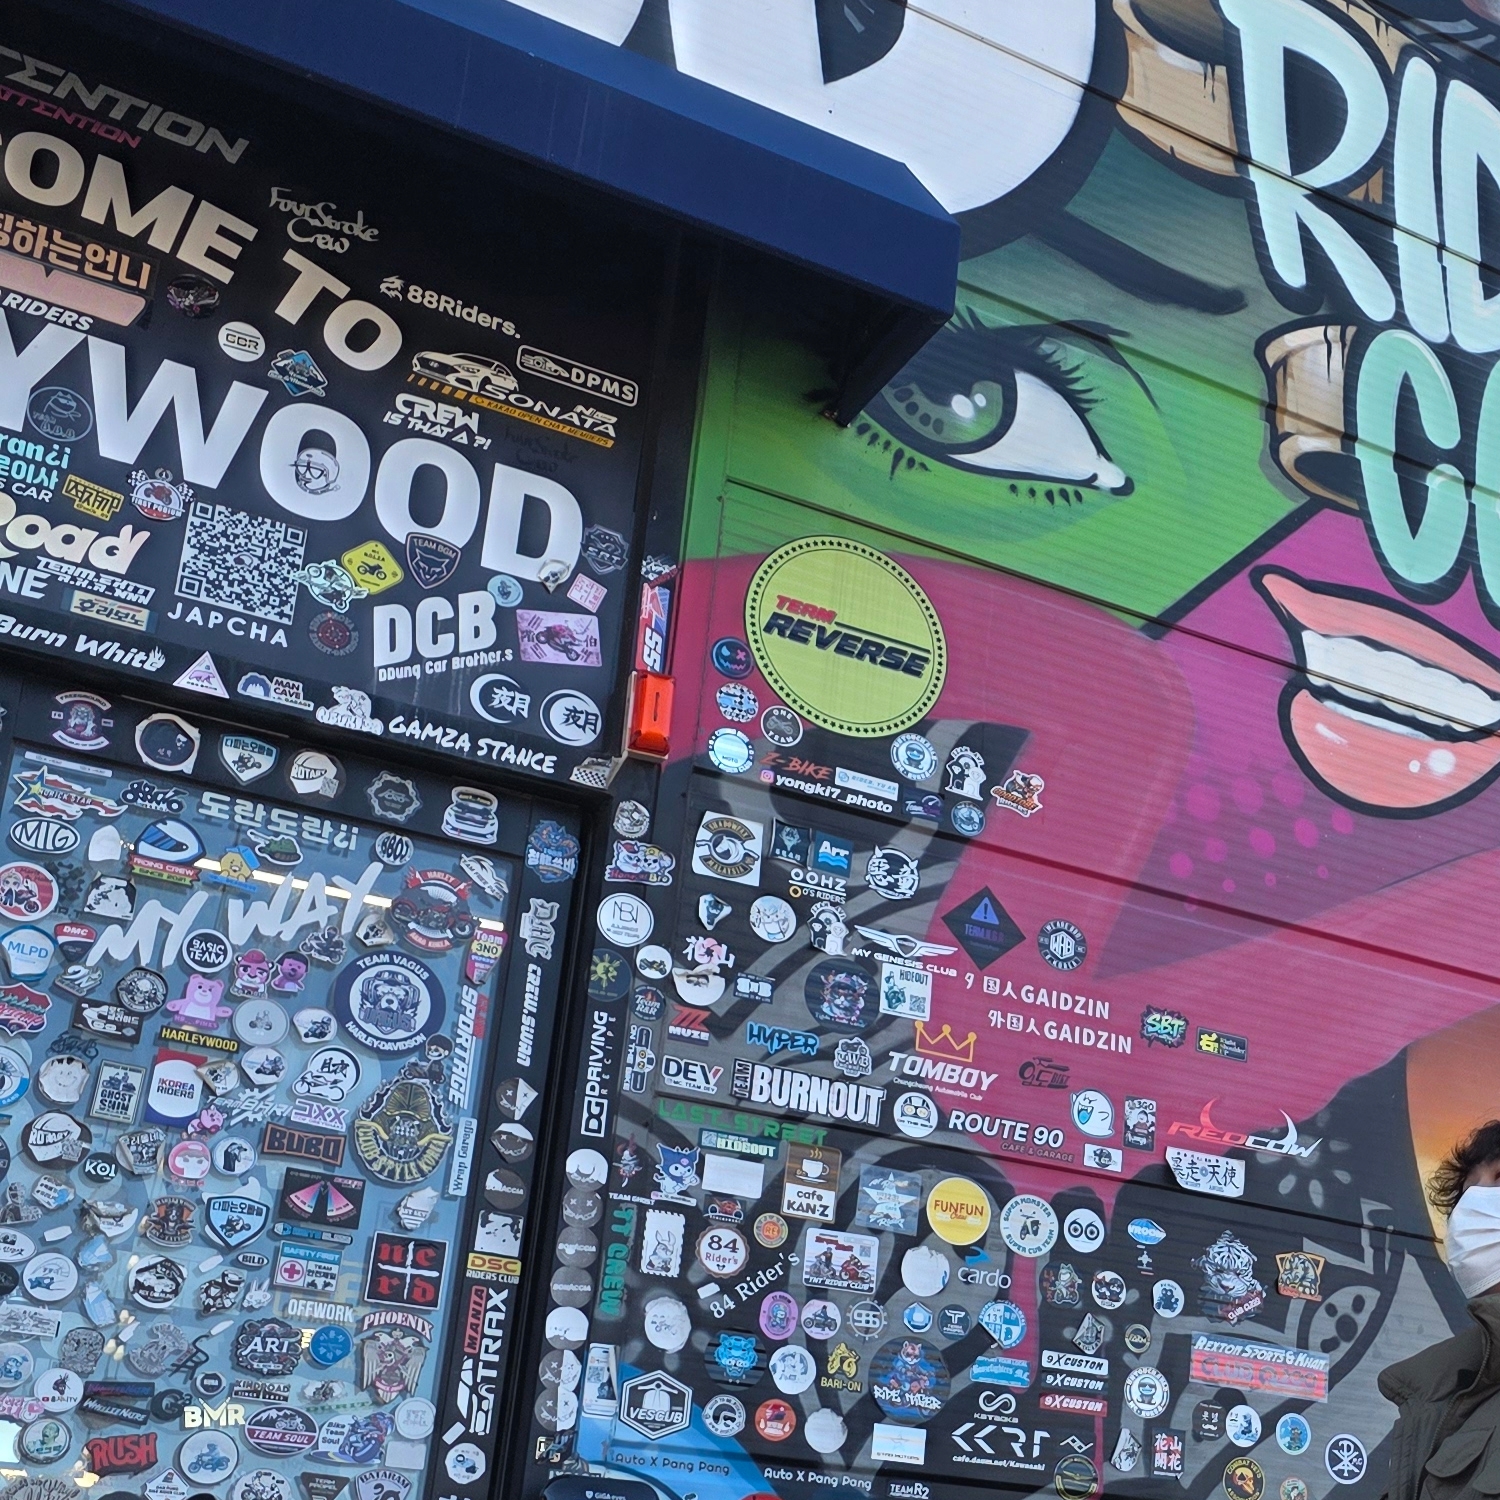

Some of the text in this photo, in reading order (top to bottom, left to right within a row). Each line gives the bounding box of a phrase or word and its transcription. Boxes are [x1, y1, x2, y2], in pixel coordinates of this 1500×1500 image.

[287, 218, 348, 253] Crew
[0, 131, 402, 371] OME TO
[5, 291, 94, 331] RIDERS
[407, 284, 521, 339] 88Riders.
[570, 367, 636, 403] DPMS
[395, 393, 479, 433] CREW
[481, 382, 617, 438] SONATA
[12, 484, 53, 502] CAR
[775, 595, 837, 624] TEAM
[167, 602, 288, 648] JAPCHA
[374, 590, 497, 667] DCB
[75, 635, 165, 672] White
[763, 612, 932, 678] REVERSE
[426, 658, 447, 675] Car
[273, 687, 302, 700] CAVE
[274, 678, 302, 690] MAN
[491, 686, 531, 718] 夜月
[562, 706, 599, 735] 夜月
[388, 715, 557, 774] GAMZA STANCE
[760, 752, 833, 780] Z-BIKE
[775, 773, 894, 814] yongki7_photo
[86, 861, 384, 968] MY WAY
[62, 923, 89, 938] DMC
[474, 930, 504, 945] Team
[8, 941, 49, 959] MLPD
[189, 946, 227, 965] TEAM
[193, 937, 226, 956] BASIC
[356, 955, 430, 981] TEAM VAGUS
[851, 948, 957, 977] MY GENESIS CLUB
[900, 970, 929, 987] HIDEOUT
[161, 1027, 239, 1052] HARLEYWOOD
[346, 1022, 428, 1054] HARLEY-DAVIDSON
[448, 984, 478, 1112] SPORTAGE
[747, 1024, 820, 1054] HYPER
[586, 1010, 609, 1095] DRIVING
[662, 1056, 724, 1084] DEV
[889, 1052, 998, 1091] TOMBOY
[101, 1088, 133, 1105] GHOST
[156, 1086, 195, 1101] RIDERS
[158, 1077, 196, 1092] KOREA
[734, 1060, 750, 1097] TEAM
[751, 1065, 885, 1126] BURNOUT
[949, 1109, 1065, 1149] ROUTE 90
[266, 1126, 342, 1165] BUBO
[717, 1139, 776, 1157] HIDEOUT
[1002, 1142, 1026, 1154] CAFE
[1037, 1149, 1074, 1163] GARAGE
[797, 1189, 824, 1202] cafe
[934, 1200, 985, 1217] FUNFUN
[705, 1251, 739, 1266] Rider's
[708, 1236, 739, 1253] 84
[466, 1268, 520, 1285] RIDERS CLUB
[469, 1255, 520, 1272] DSC
[958, 1264, 1012, 1289] cardo
[708, 1250, 801, 1319] 84 Rider's
[287, 1297, 354, 1324] OFFWORK
[466, 1288, 487, 1352] MANIA
[363, 1311, 434, 1341] PHOENIX
[244, 1336, 290, 1354] ARI
[821, 1377, 862, 1392] BARI-ON
[184, 1397, 246, 1428] BMR
[252, 1428, 310, 1445] TEAM SOUL
[90, 1433, 159, 1470] RUSH
[615, 1453, 730, 1477] Auto X Pang Pang
[764, 1467, 873, 1492] Auto X Pang Pang
